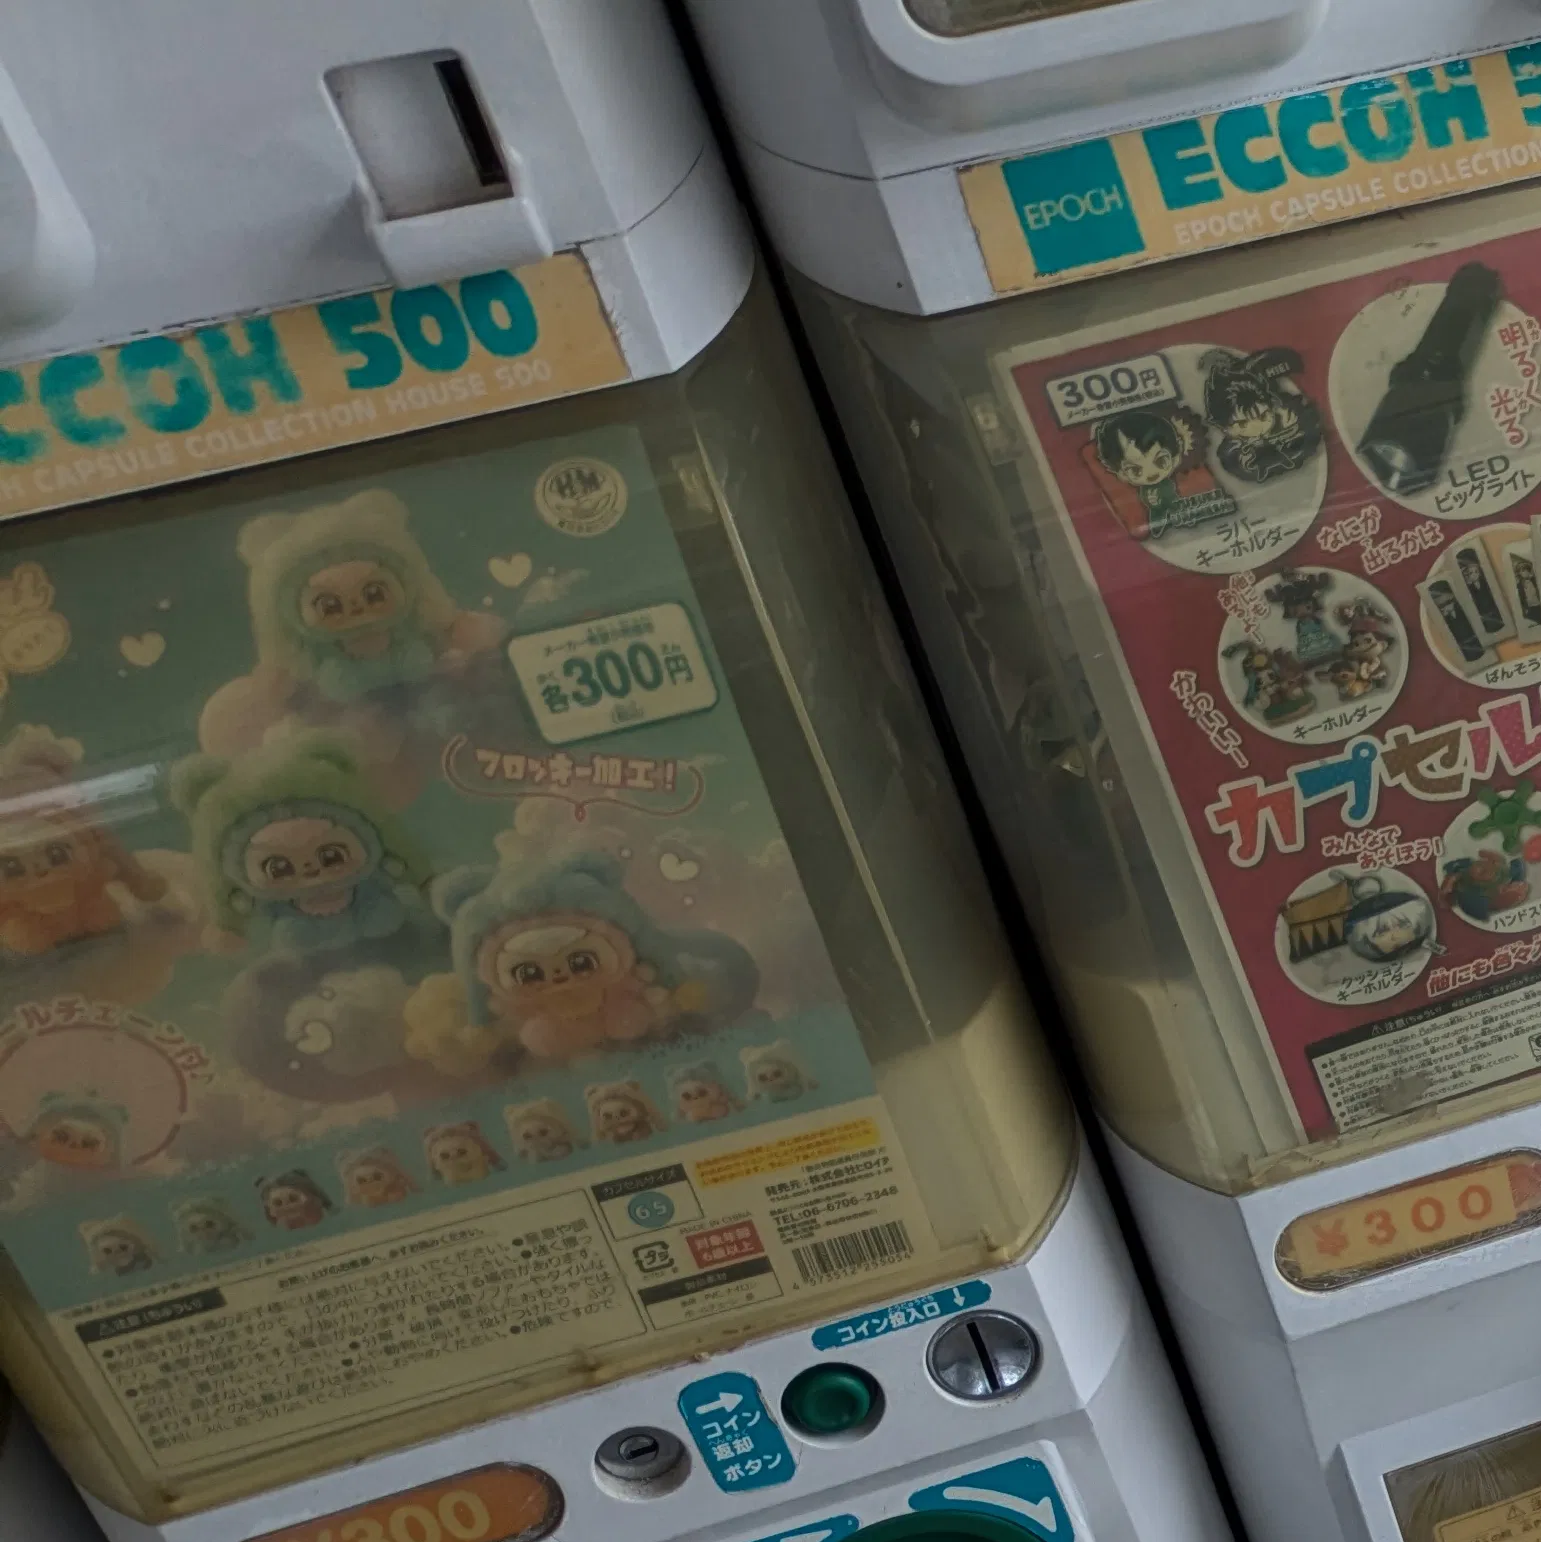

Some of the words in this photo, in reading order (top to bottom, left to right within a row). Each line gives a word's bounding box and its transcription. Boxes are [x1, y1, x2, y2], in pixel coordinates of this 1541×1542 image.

[1143, 58, 1491, 211] ECCOH
[1023, 184, 1125, 232] EPOCH
[1173, 211, 1262, 247] EPOCH
[1269, 180, 1388, 226] CAPSULE
[317, 269, 539, 391] 500
[1056, 367, 1161, 408] 300円
[33, 441, 178, 494] CAPSULE
[185, 397, 377, 463] COLLECTION
[384, 372, 488, 418] HOUSE
[494, 358, 553, 389] 500
[1490, 386, 1528, 447] 光る
[1434, 469, 1536, 513] ビッグライト
[1448, 455, 1511, 488] LED
[1195, 527, 1300, 567] キーホルダー
[1216, 516, 1267, 541] ラバー
[1292, 705, 1383, 740] キーホルダー
[1337, 970, 1416, 1001] キーホルダー
[1341, 960, 1404, 988] クッション
[635, 1201, 668, 1220] 65
[837, 1302, 941, 1343] コイン投入口
[702, 1411, 761, 1440] コイン
[711, 1436, 755, 1462] 返却
[723, 1452, 782, 1482] ボタン
